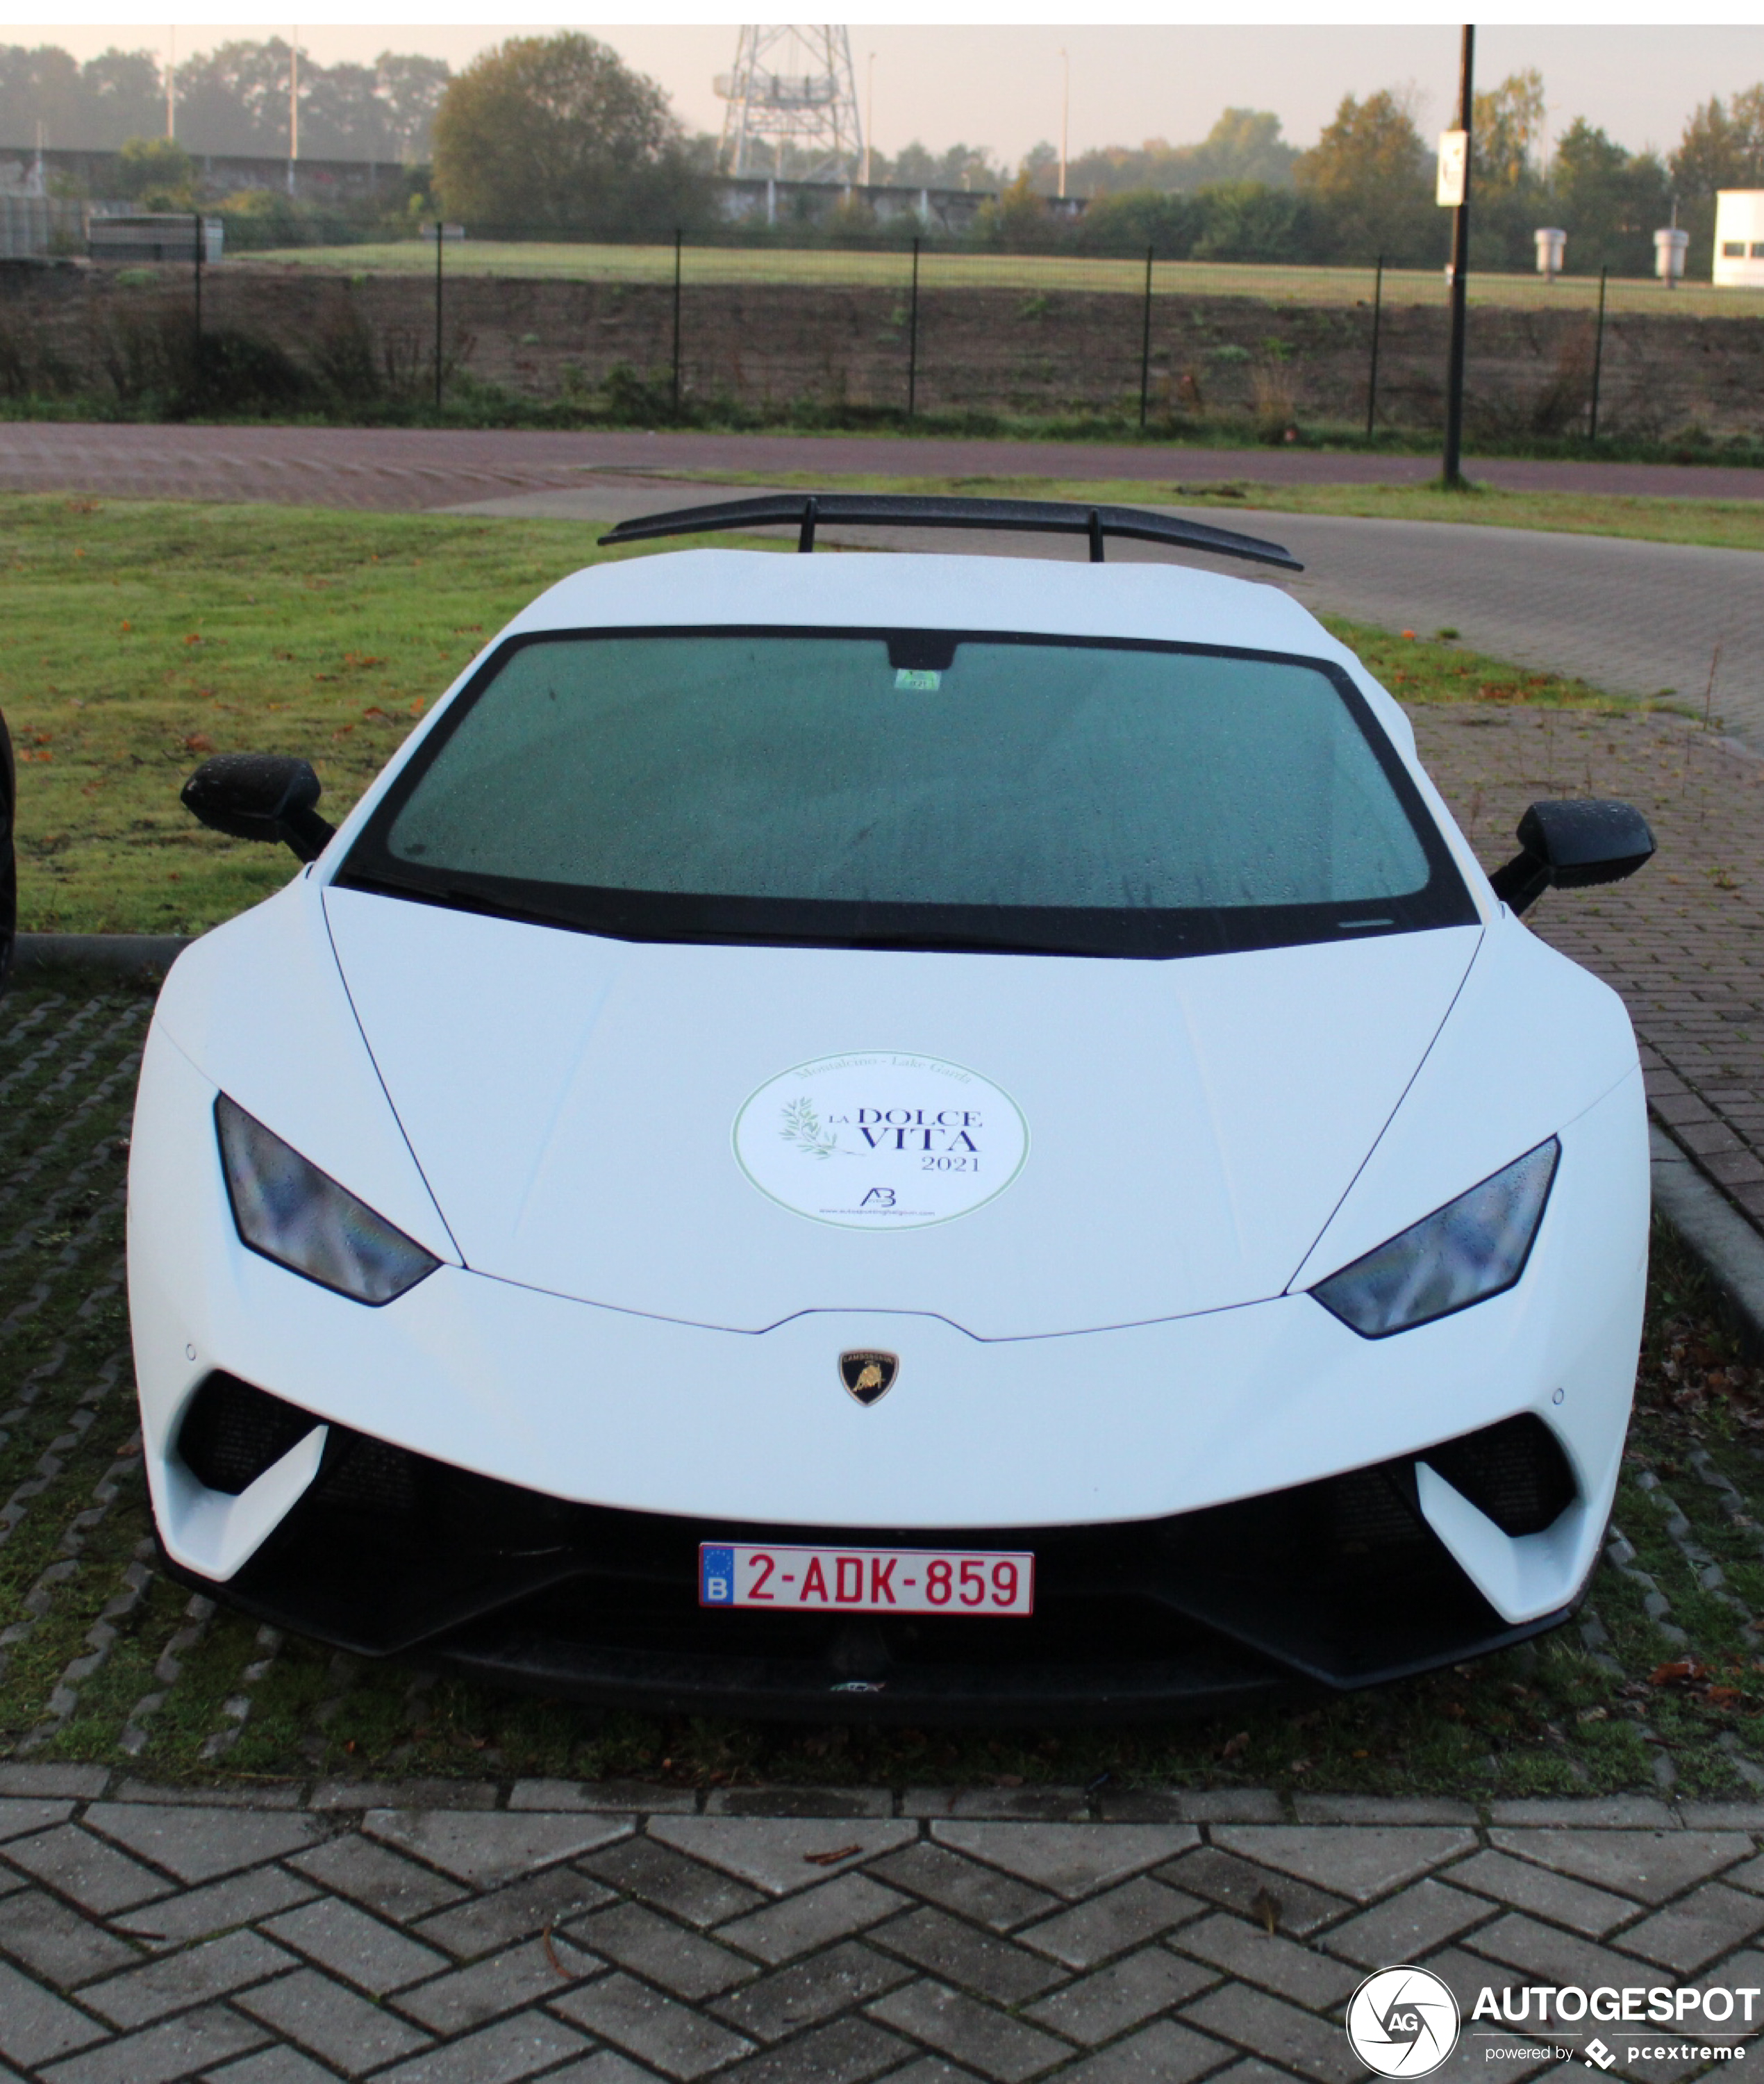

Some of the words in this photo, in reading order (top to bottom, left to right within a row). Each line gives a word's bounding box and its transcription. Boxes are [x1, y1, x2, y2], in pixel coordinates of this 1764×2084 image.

[892, 1056, 926, 1068] Lake
[930, 1064, 971, 1084] Garda
[857, 1108, 983, 1127] DOLCE
[857, 1127, 982, 1152] VITA
[922, 1156, 980, 1172] 2021
[708, 1578, 728, 1601] B
[747, 1554, 1018, 1607] 2-ADK-859
